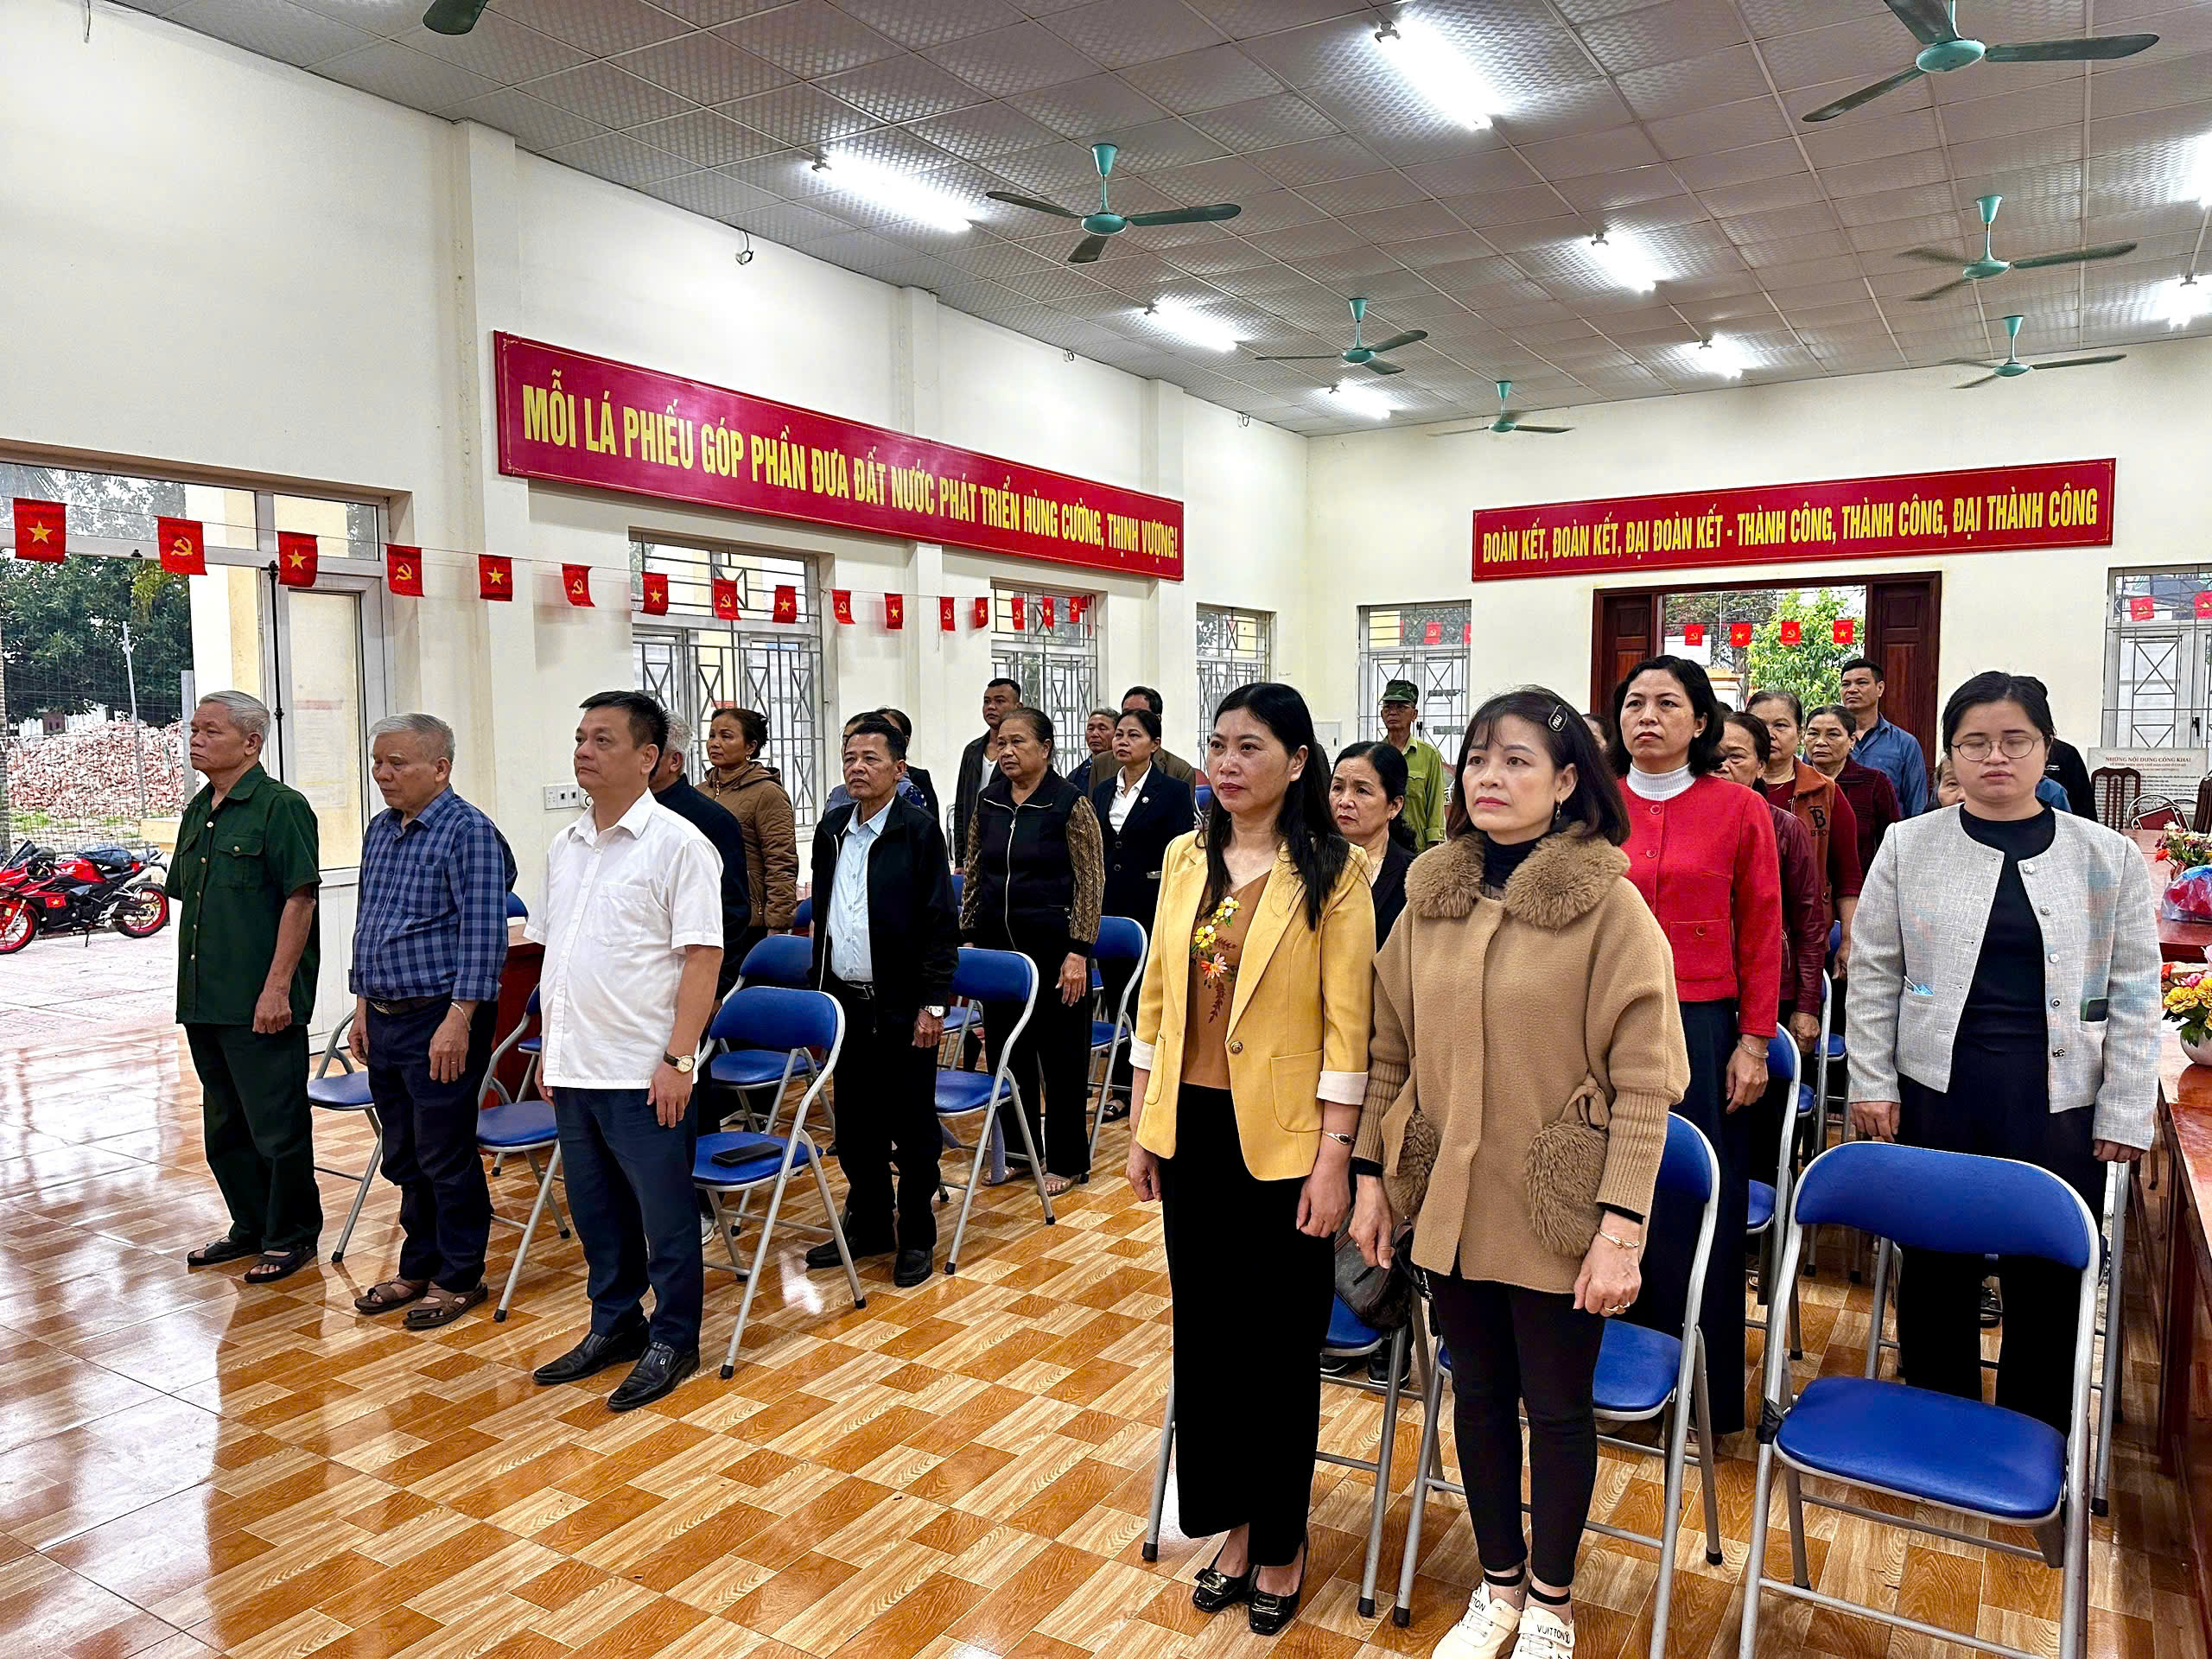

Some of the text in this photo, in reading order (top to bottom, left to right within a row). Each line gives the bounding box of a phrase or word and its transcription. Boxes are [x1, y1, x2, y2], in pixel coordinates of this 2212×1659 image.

[523, 369, 1178, 563] MỖI LÁ PHIẾU GÓP PHẦN ĐƯA ĐẤT NƯỚC PHÁT TRIỂN HÙNG CƯỜNG, THỊNH VƯỢNG!
[1483, 525, 1518, 563] ĐOÀN
[1521, 518, 1549, 563] KẾT,
[1553, 519, 1589, 558] ĐOÀN
[1593, 512, 1622, 558] KẾT,
[1625, 520, 1649, 560] ĐẠI
[1653, 512, 1693, 551] ĐOÀN
[1696, 504, 1724, 550] KẾT
[1738, 505, 1786, 546] THÀNH
[1790, 501, 1837, 544] CÔNG,
[1841, 498, 1893, 540] THÀNH
[1898, 493, 1948, 538] CÔNG,
[1953, 497, 1982, 540] ĐẠI
[1987, 486, 2044, 531] THÀNH
[2049, 482, 2098, 527] CÔNG
[1536, 1624, 1565, 1641] VUITTON
